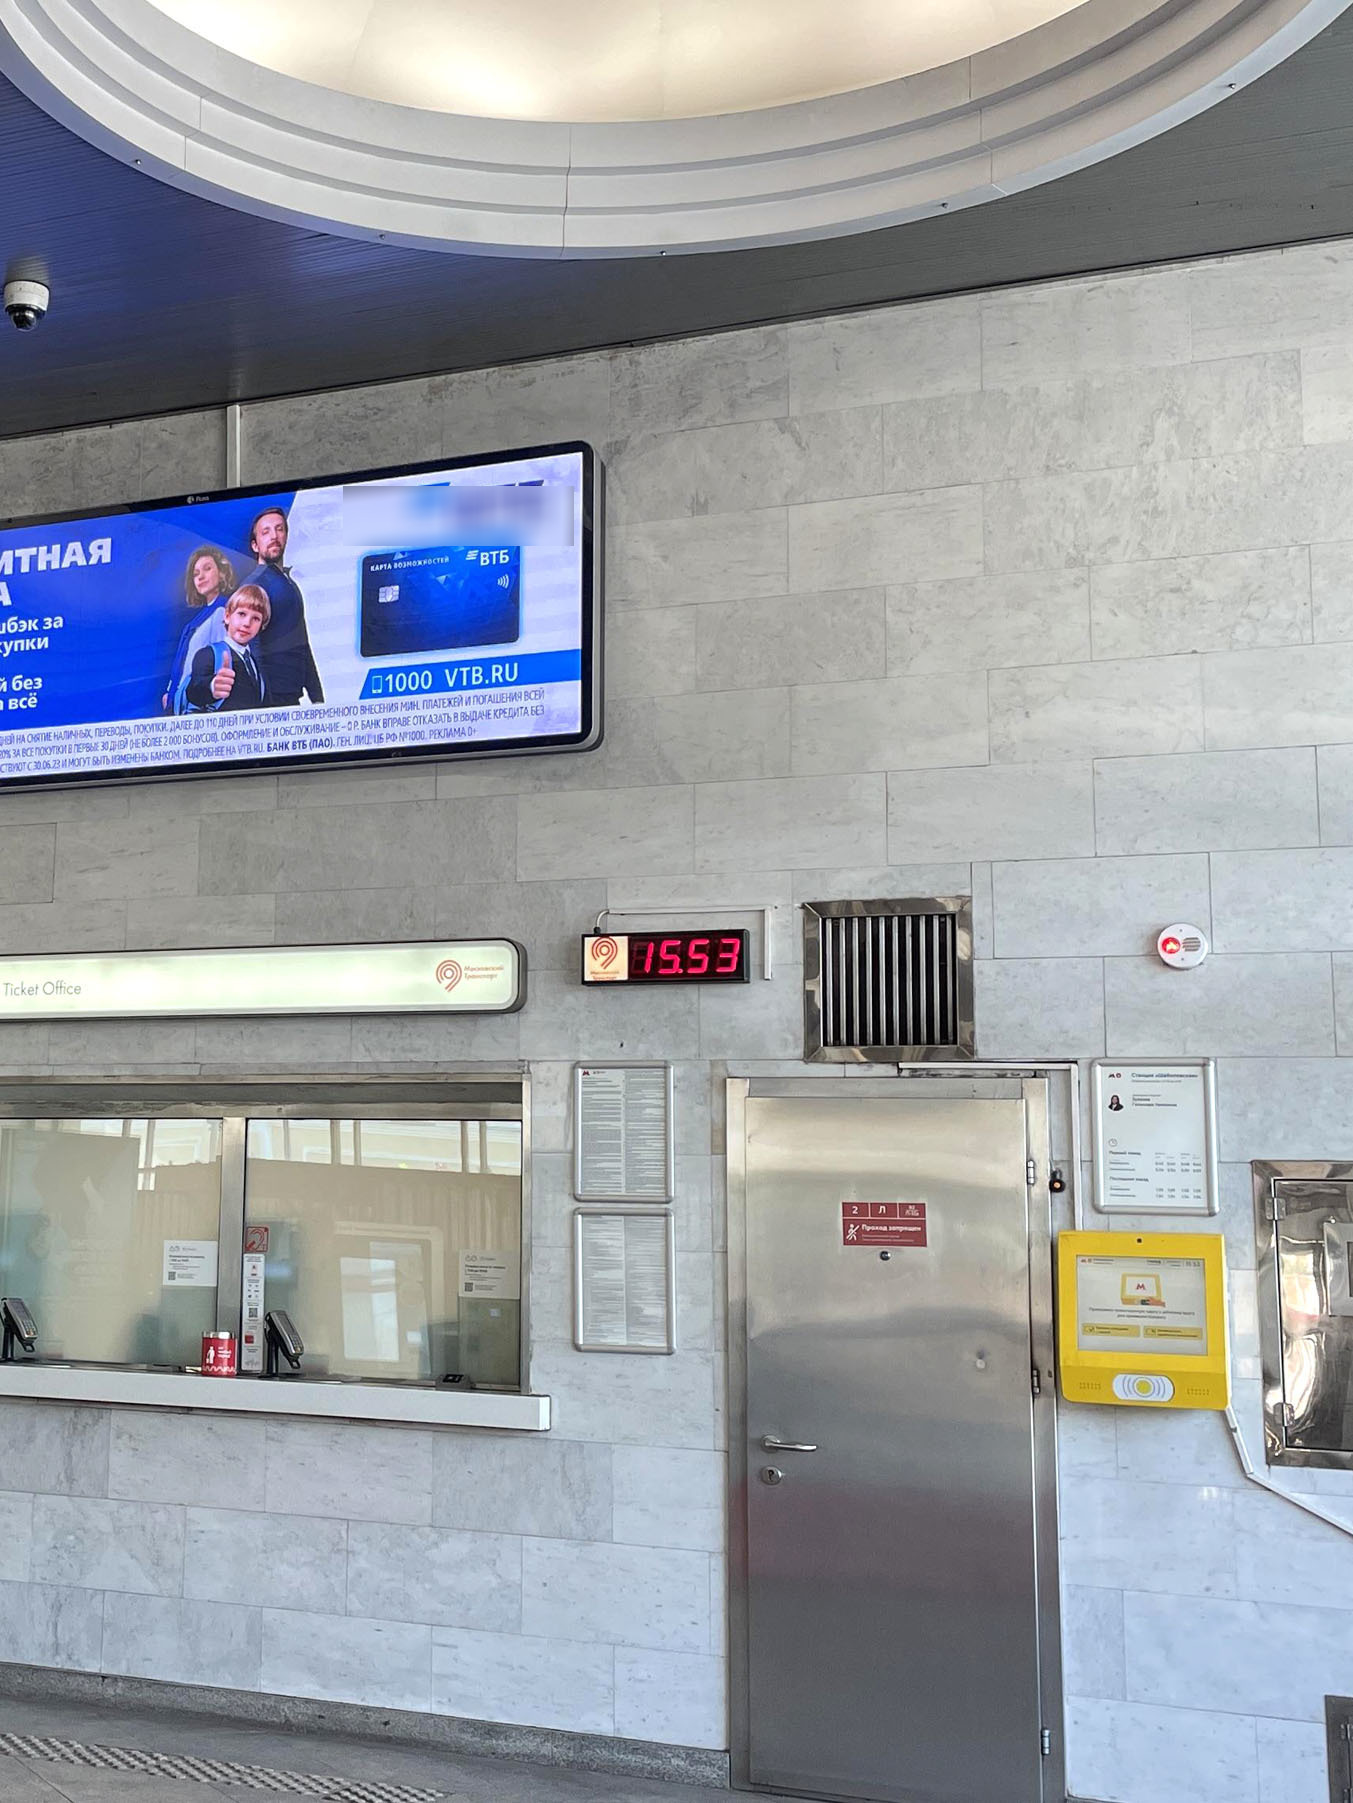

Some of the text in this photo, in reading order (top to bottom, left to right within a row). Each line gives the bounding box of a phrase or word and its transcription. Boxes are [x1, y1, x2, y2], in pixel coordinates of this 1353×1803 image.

[370, 556, 450, 571] КАРТА ВОЗМОЖНОСТЕЙ
[480, 549, 510, 566] ВТБ
[42, 615, 64, 630] за
[11, 674, 43, 692] без
[384, 662, 519, 692] 1000 VTB.RU
[8, 692, 38, 711] всё
[291, 706, 358, 721] СВОЕВРЕМЕННОГО
[360, 703, 398, 715] ВНЕСЕНИЯ
[422, 695, 463, 709] ПЛАТЕЖЕЙ
[473, 692, 522, 705] ПОГАШЕНИЯ
[524, 688, 544, 701] ВСЕЙ
[221, 728, 271, 741] ОФОРМЛЕНИЕ
[280, 722, 340, 736] ОБСЛУЖИВАНИЕ
[361, 719, 380, 729] БАНК
[382, 716, 412, 728] ВПРАВЕ
[412, 713, 452, 725] ОТКАЗАТЬ
[460, 710, 491, 722] ВЫДАЧЕ
[493, 707, 529, 720] КРЕДИТА
[530, 706, 544, 716] БЕЗ
[266, 741, 290, 752] БАНК
[292, 739, 308, 750] ВТБ
[429, 727, 466, 739] РЕКЛАМА
[3, 980, 82, 997] Ticket Office
[851, 1205, 859, 1215] 2
[861, 1223, 888, 1232] Проход
